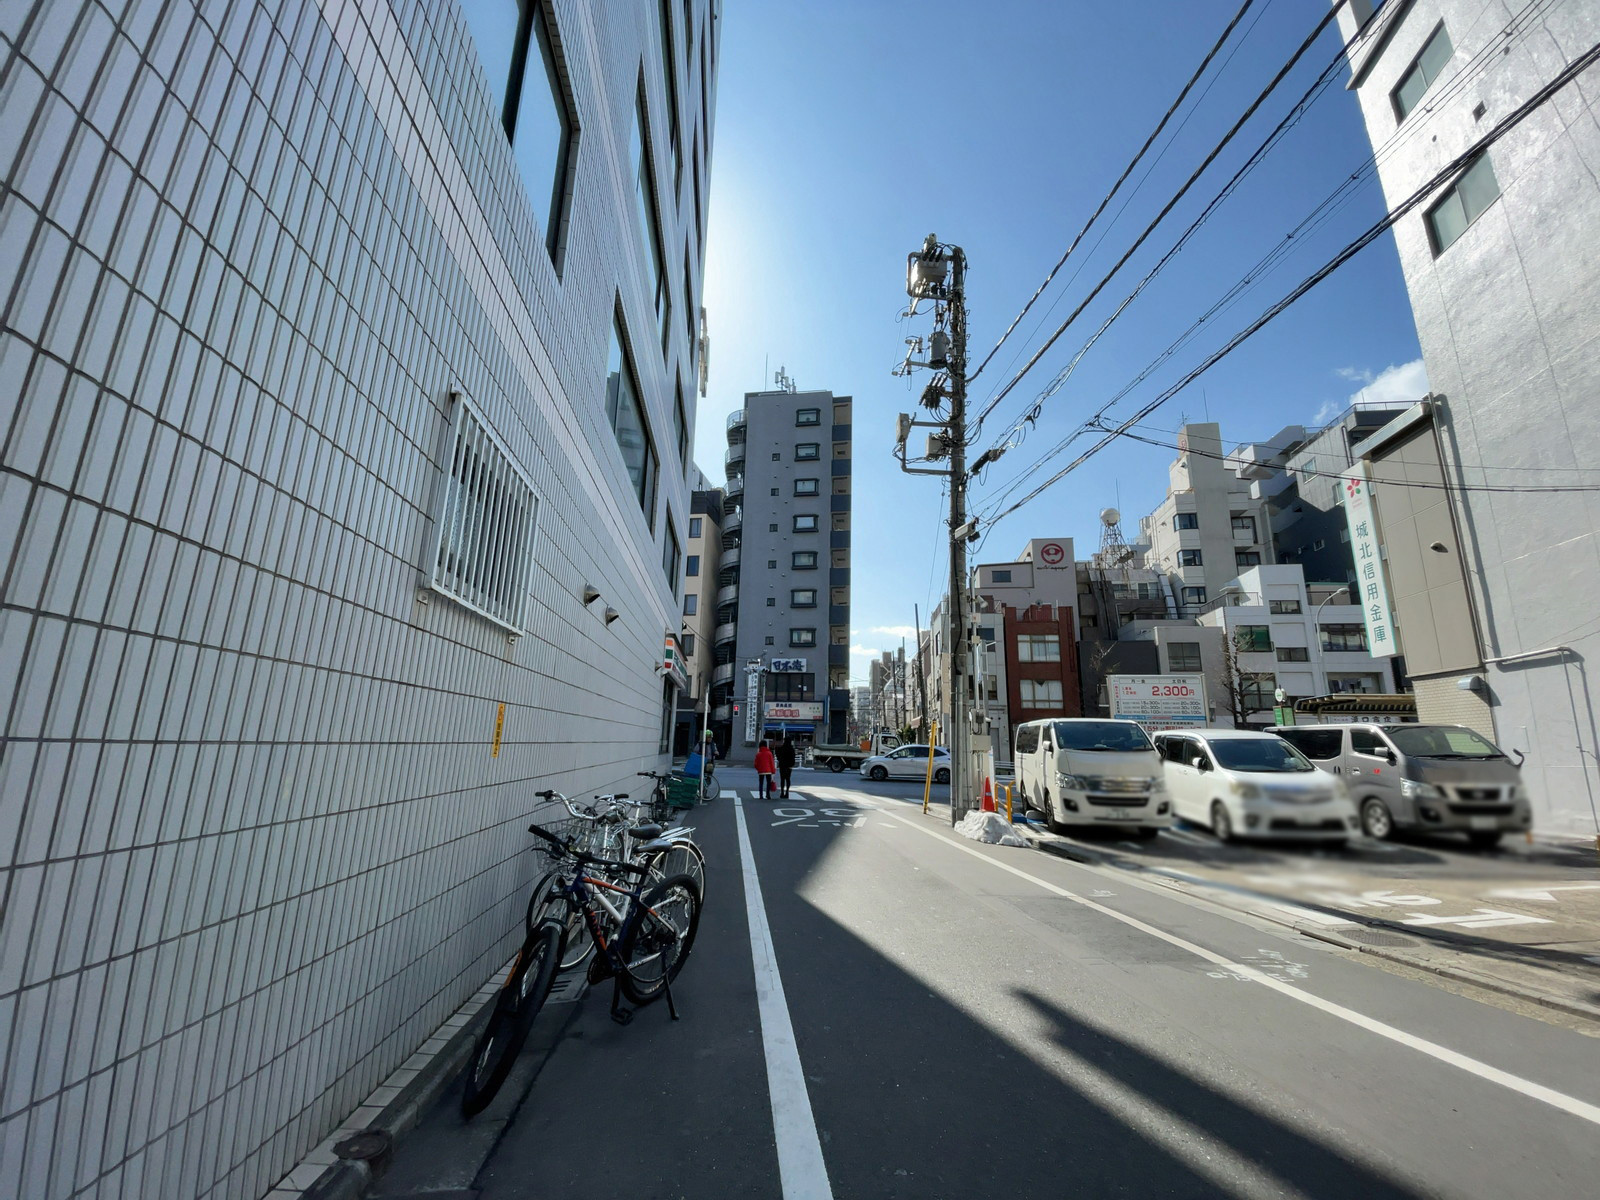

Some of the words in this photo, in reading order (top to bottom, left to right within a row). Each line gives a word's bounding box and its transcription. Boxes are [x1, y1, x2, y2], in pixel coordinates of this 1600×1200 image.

[1355, 520, 1387, 643] 城北信用金庫
[773, 659, 804, 672] 日本海
[1152, 685, 1195, 697] 2,300円
[772, 807, 865, 818] 30
